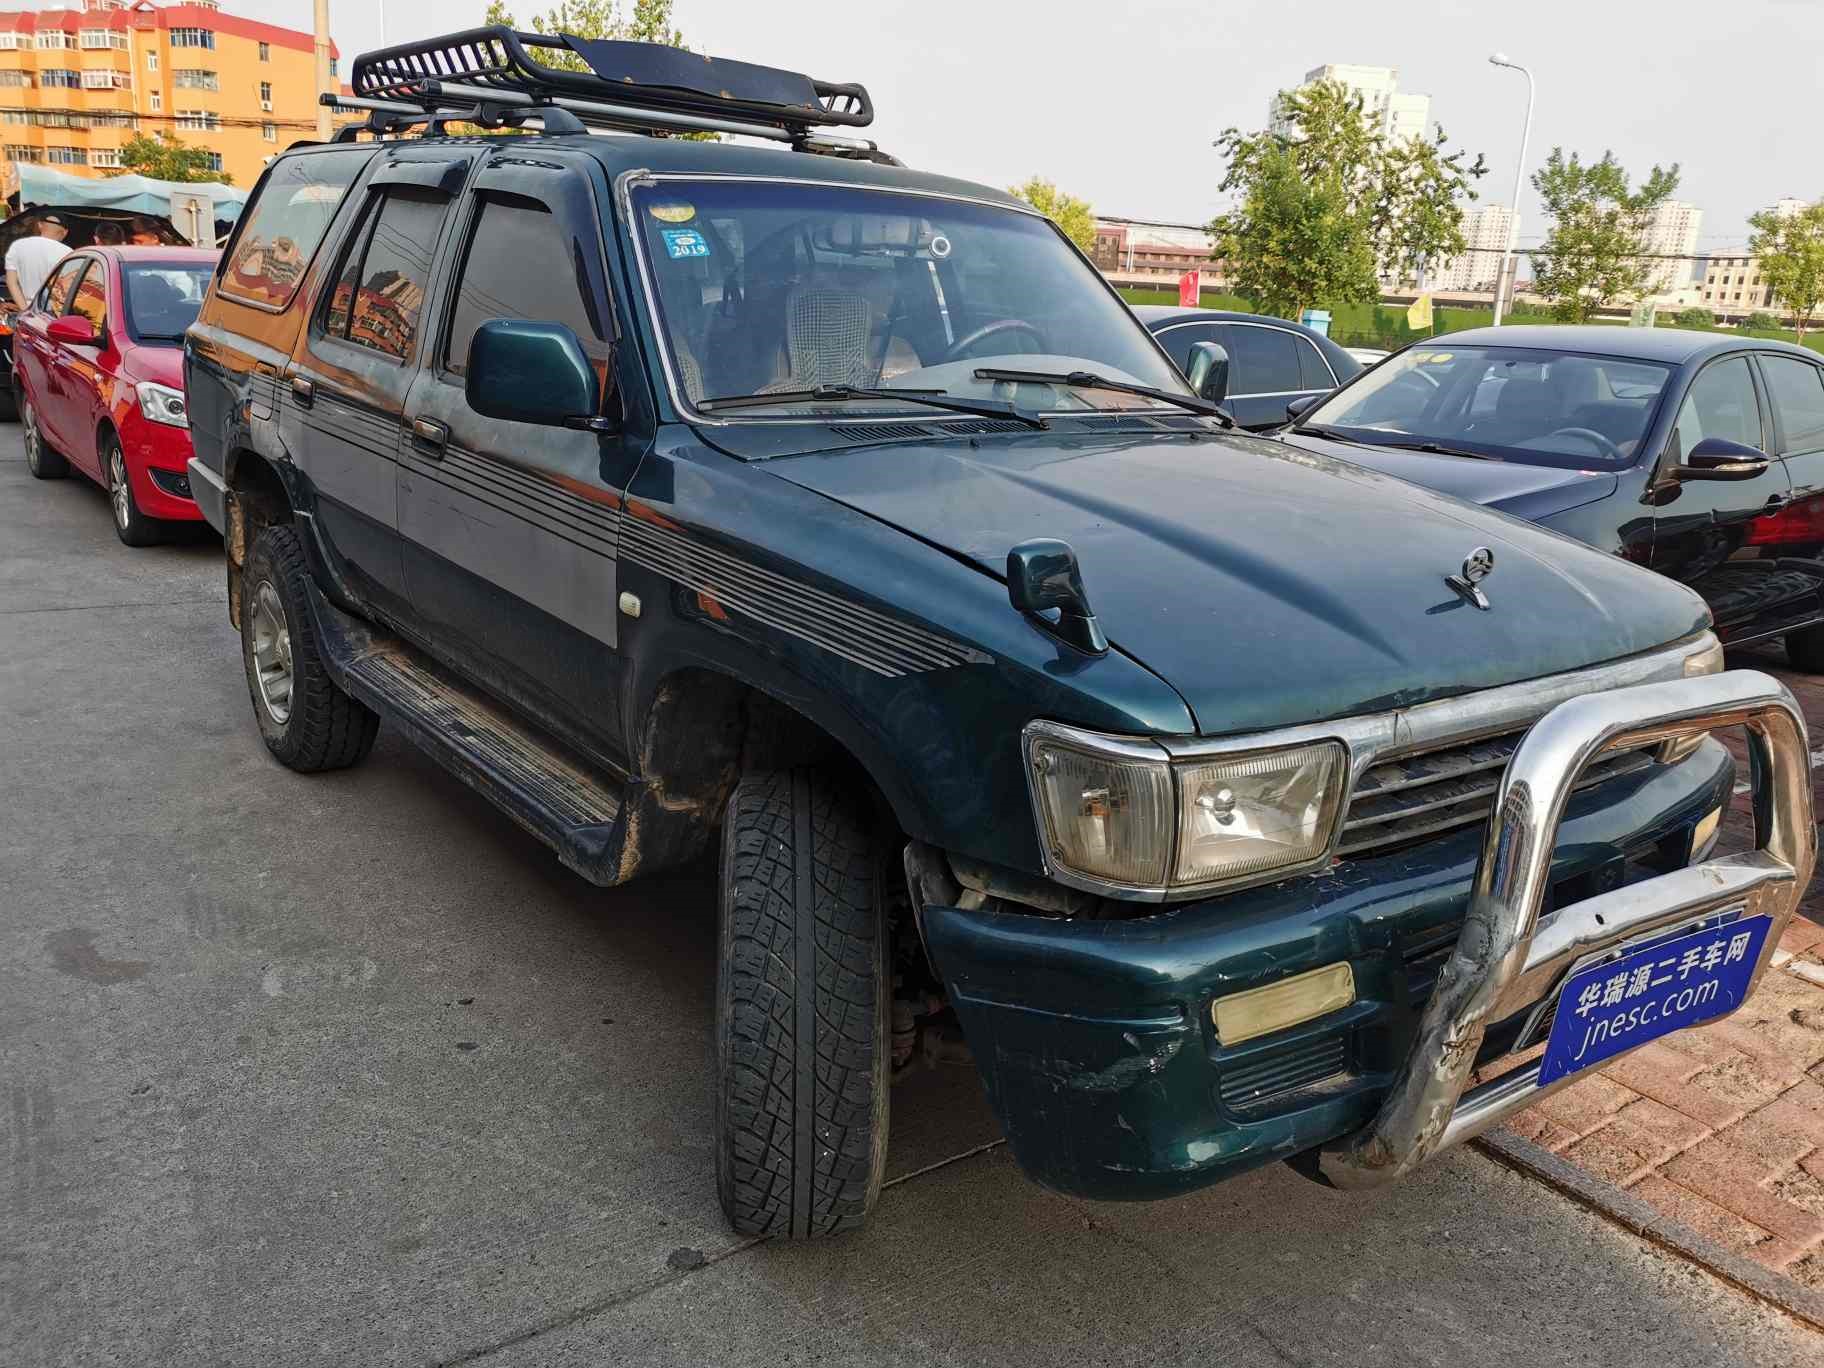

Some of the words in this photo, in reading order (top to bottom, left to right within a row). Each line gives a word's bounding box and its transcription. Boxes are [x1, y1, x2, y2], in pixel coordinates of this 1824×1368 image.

[673, 245, 705, 256] 2019
[1575, 931, 1751, 1018] 华瑞源二手车网
[1574, 978, 1718, 1061] jnesc.com
